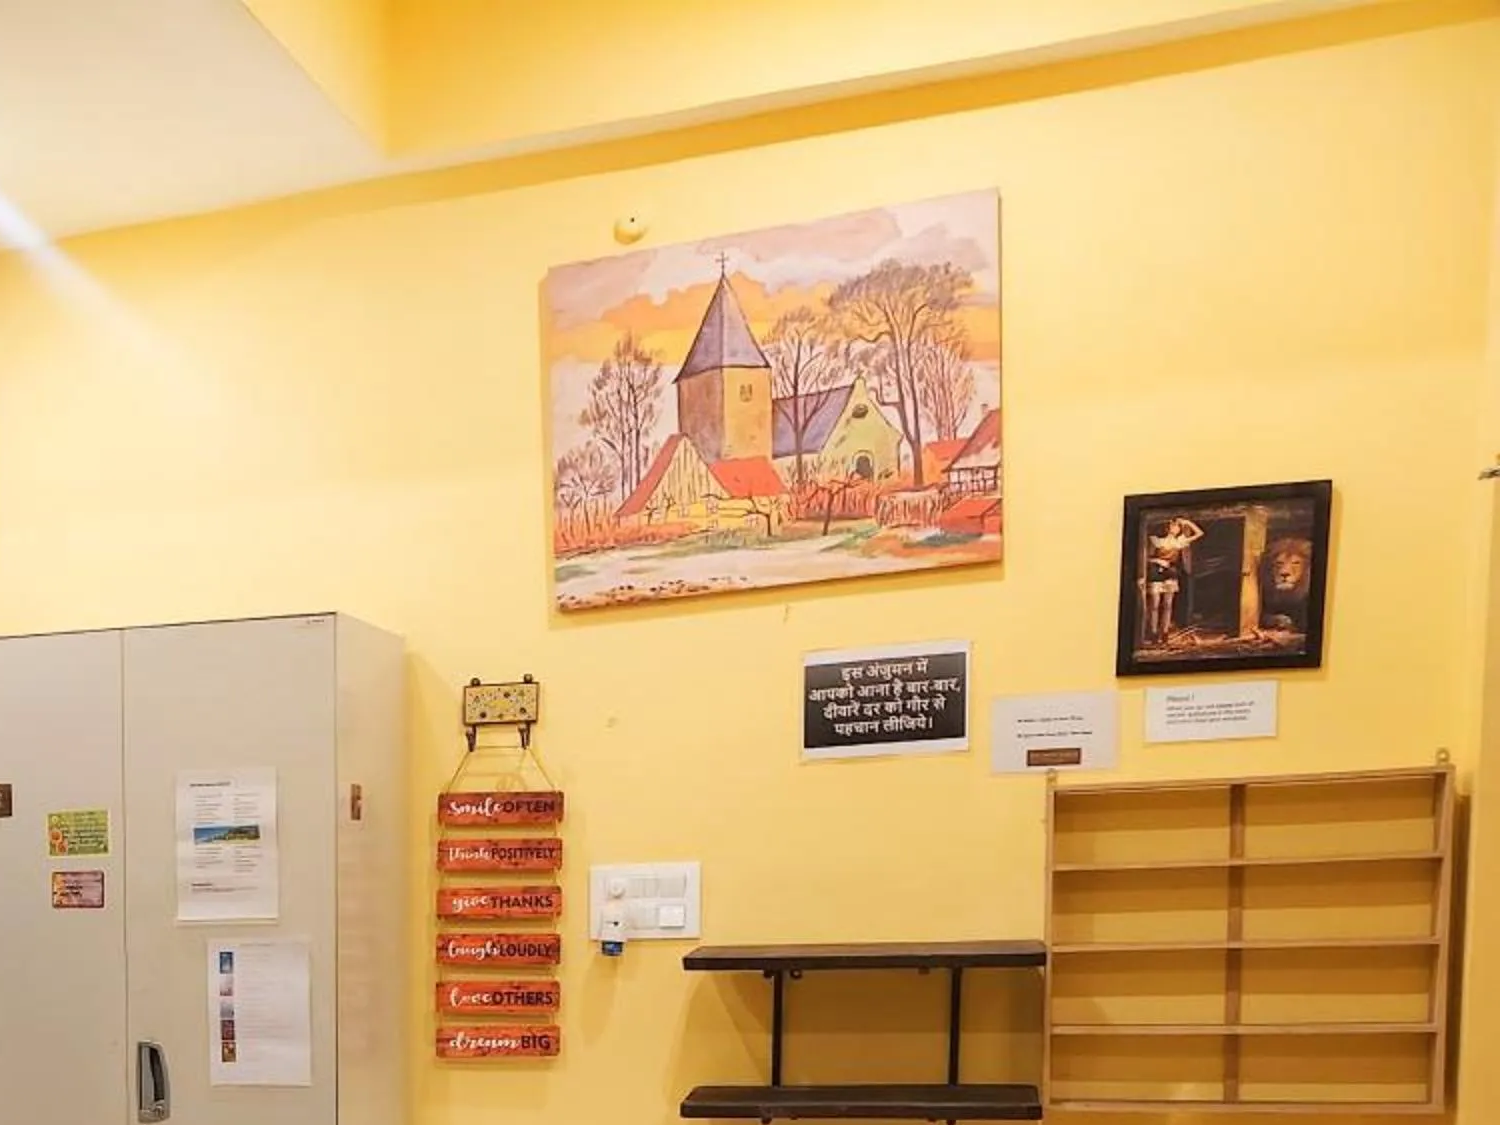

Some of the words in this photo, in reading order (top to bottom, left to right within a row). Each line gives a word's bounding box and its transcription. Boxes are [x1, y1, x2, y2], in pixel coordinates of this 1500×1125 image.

[841, 666, 863, 681] इस
[892, 678, 902, 697] है
[884, 697, 902, 714] को
[503, 801, 555, 813] OFTEN
[491, 847, 554, 859] POSITIVELY
[489, 896, 553, 908] THANKS
[500, 943, 552, 957] LOUDLY
[492, 991, 553, 1005] OTHERS
[521, 1035, 551, 1049] BIG
